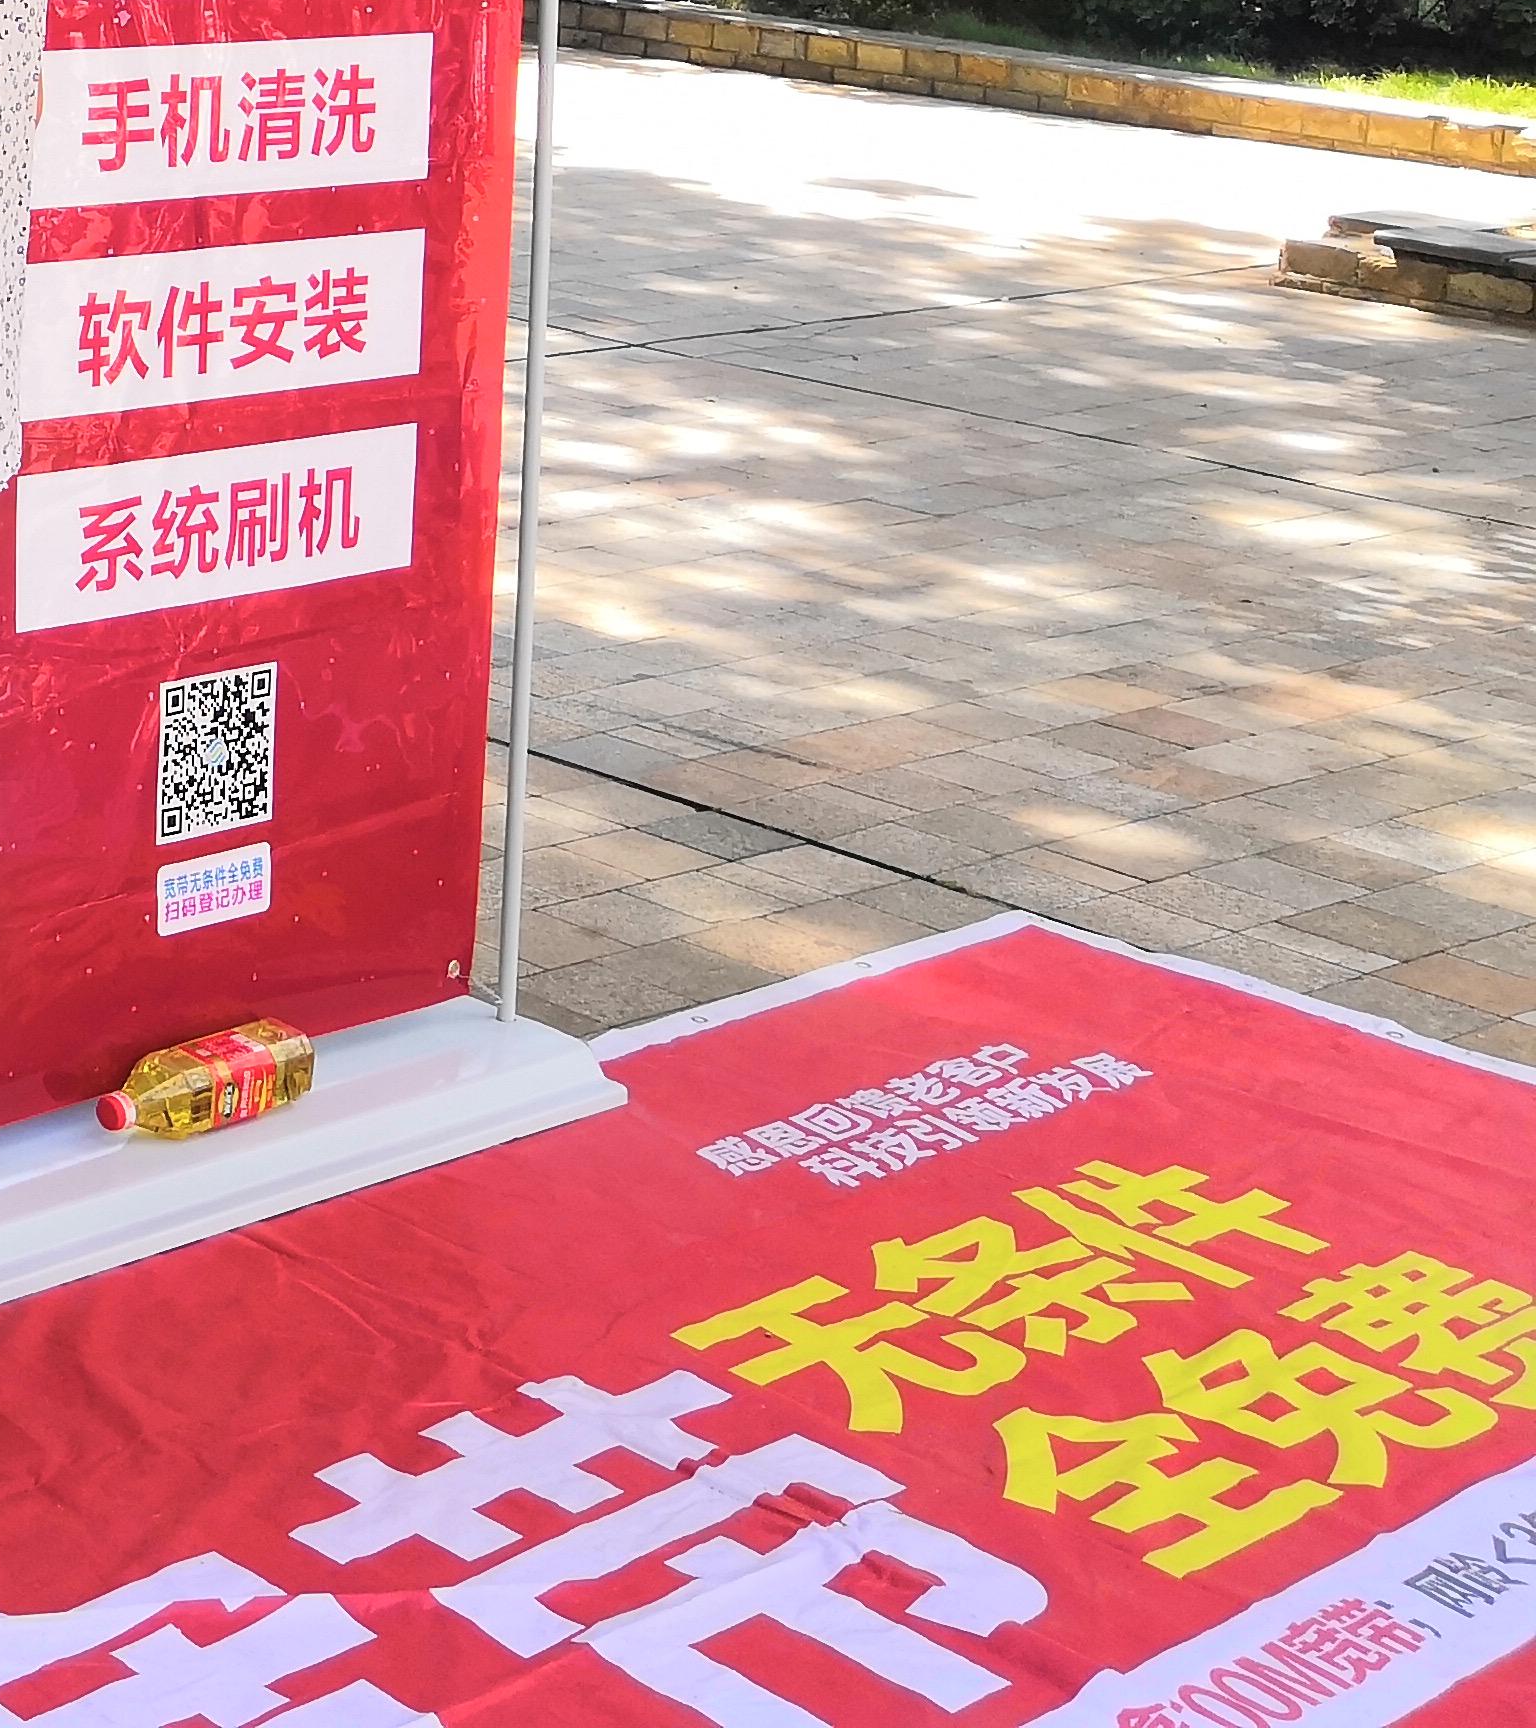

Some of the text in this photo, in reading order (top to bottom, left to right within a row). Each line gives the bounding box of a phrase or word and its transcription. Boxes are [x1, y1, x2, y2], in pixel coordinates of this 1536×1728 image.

[80, 65, 378, 172] 手机清洗
[77, 267, 370, 388] 软件安装
[76, 466, 361, 594] 系统刷机
[163, 857, 264, 900] 宽带无条件全免费
[164, 880, 263, 923] 扫码登记办理
[695, 1042, 1032, 1178] 感恩回馈老客户
[800, 1052, 1156, 1188] 科技引领新发展
[670, 1160, 1331, 1434] 无条件
[993, 1251, 1536, 1578] 全免费
